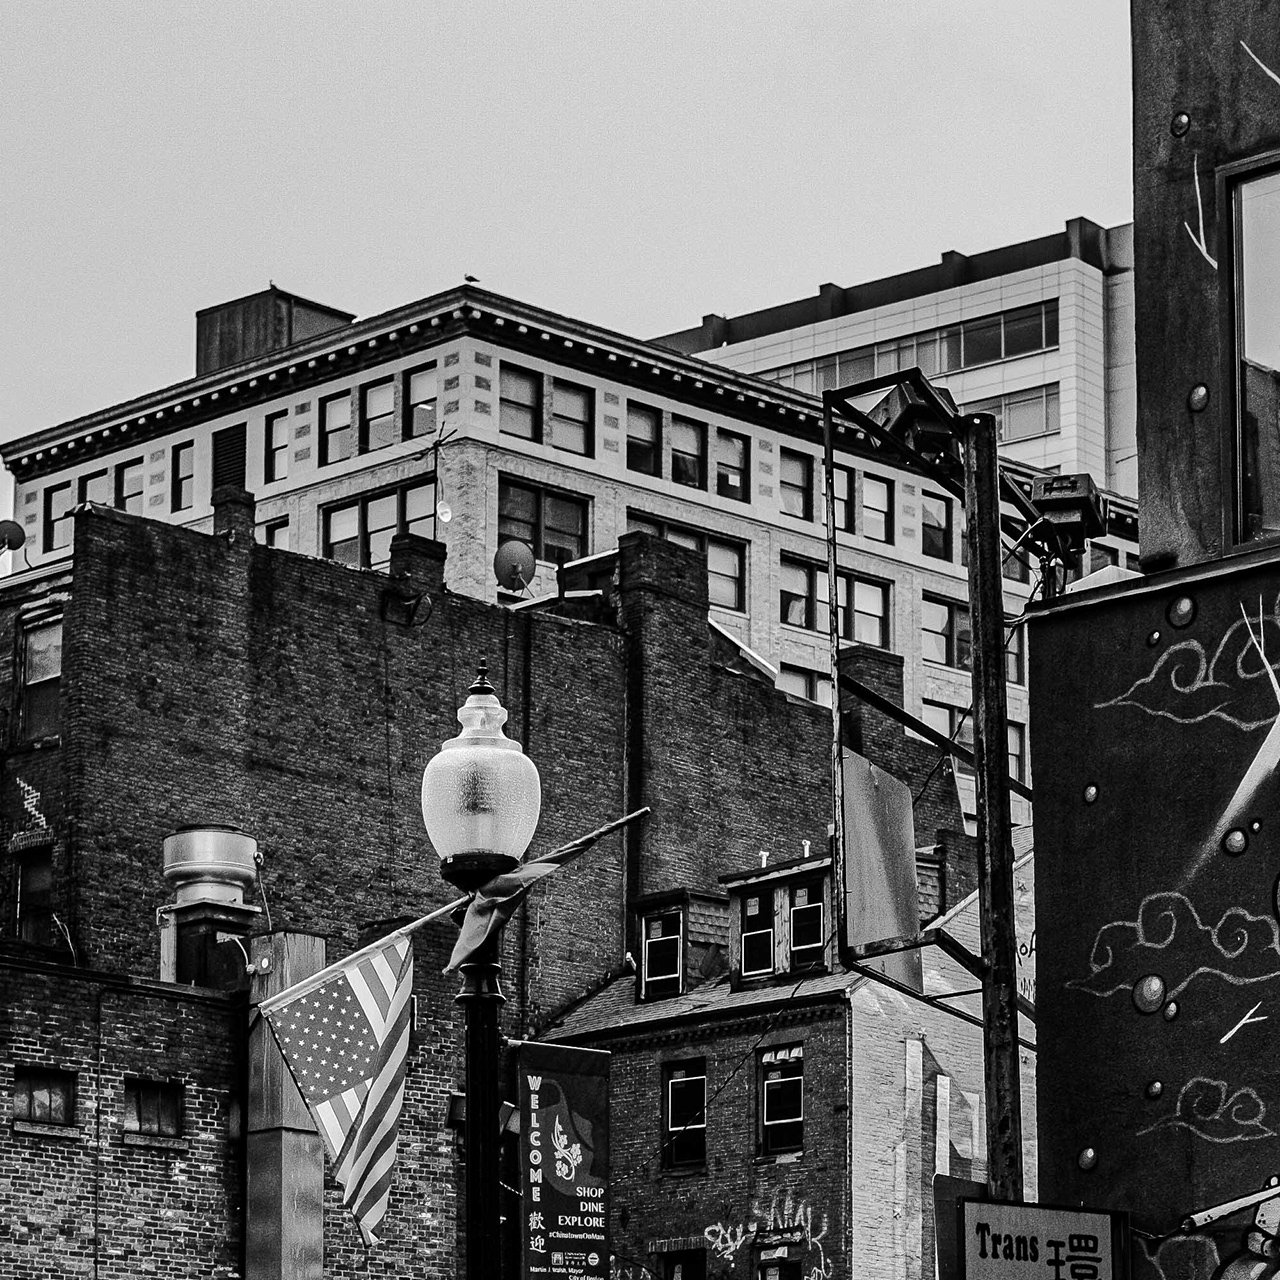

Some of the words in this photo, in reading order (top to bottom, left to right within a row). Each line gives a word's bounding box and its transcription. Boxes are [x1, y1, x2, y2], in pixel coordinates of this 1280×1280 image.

[527, 1075, 542, 1202] WELCOME
[576, 1186, 605, 1198] SHOP
[580, 1201, 605, 1213] DINE
[558, 1215, 605, 1228] EXPLORE
[975, 1222, 1039, 1263] Trans
